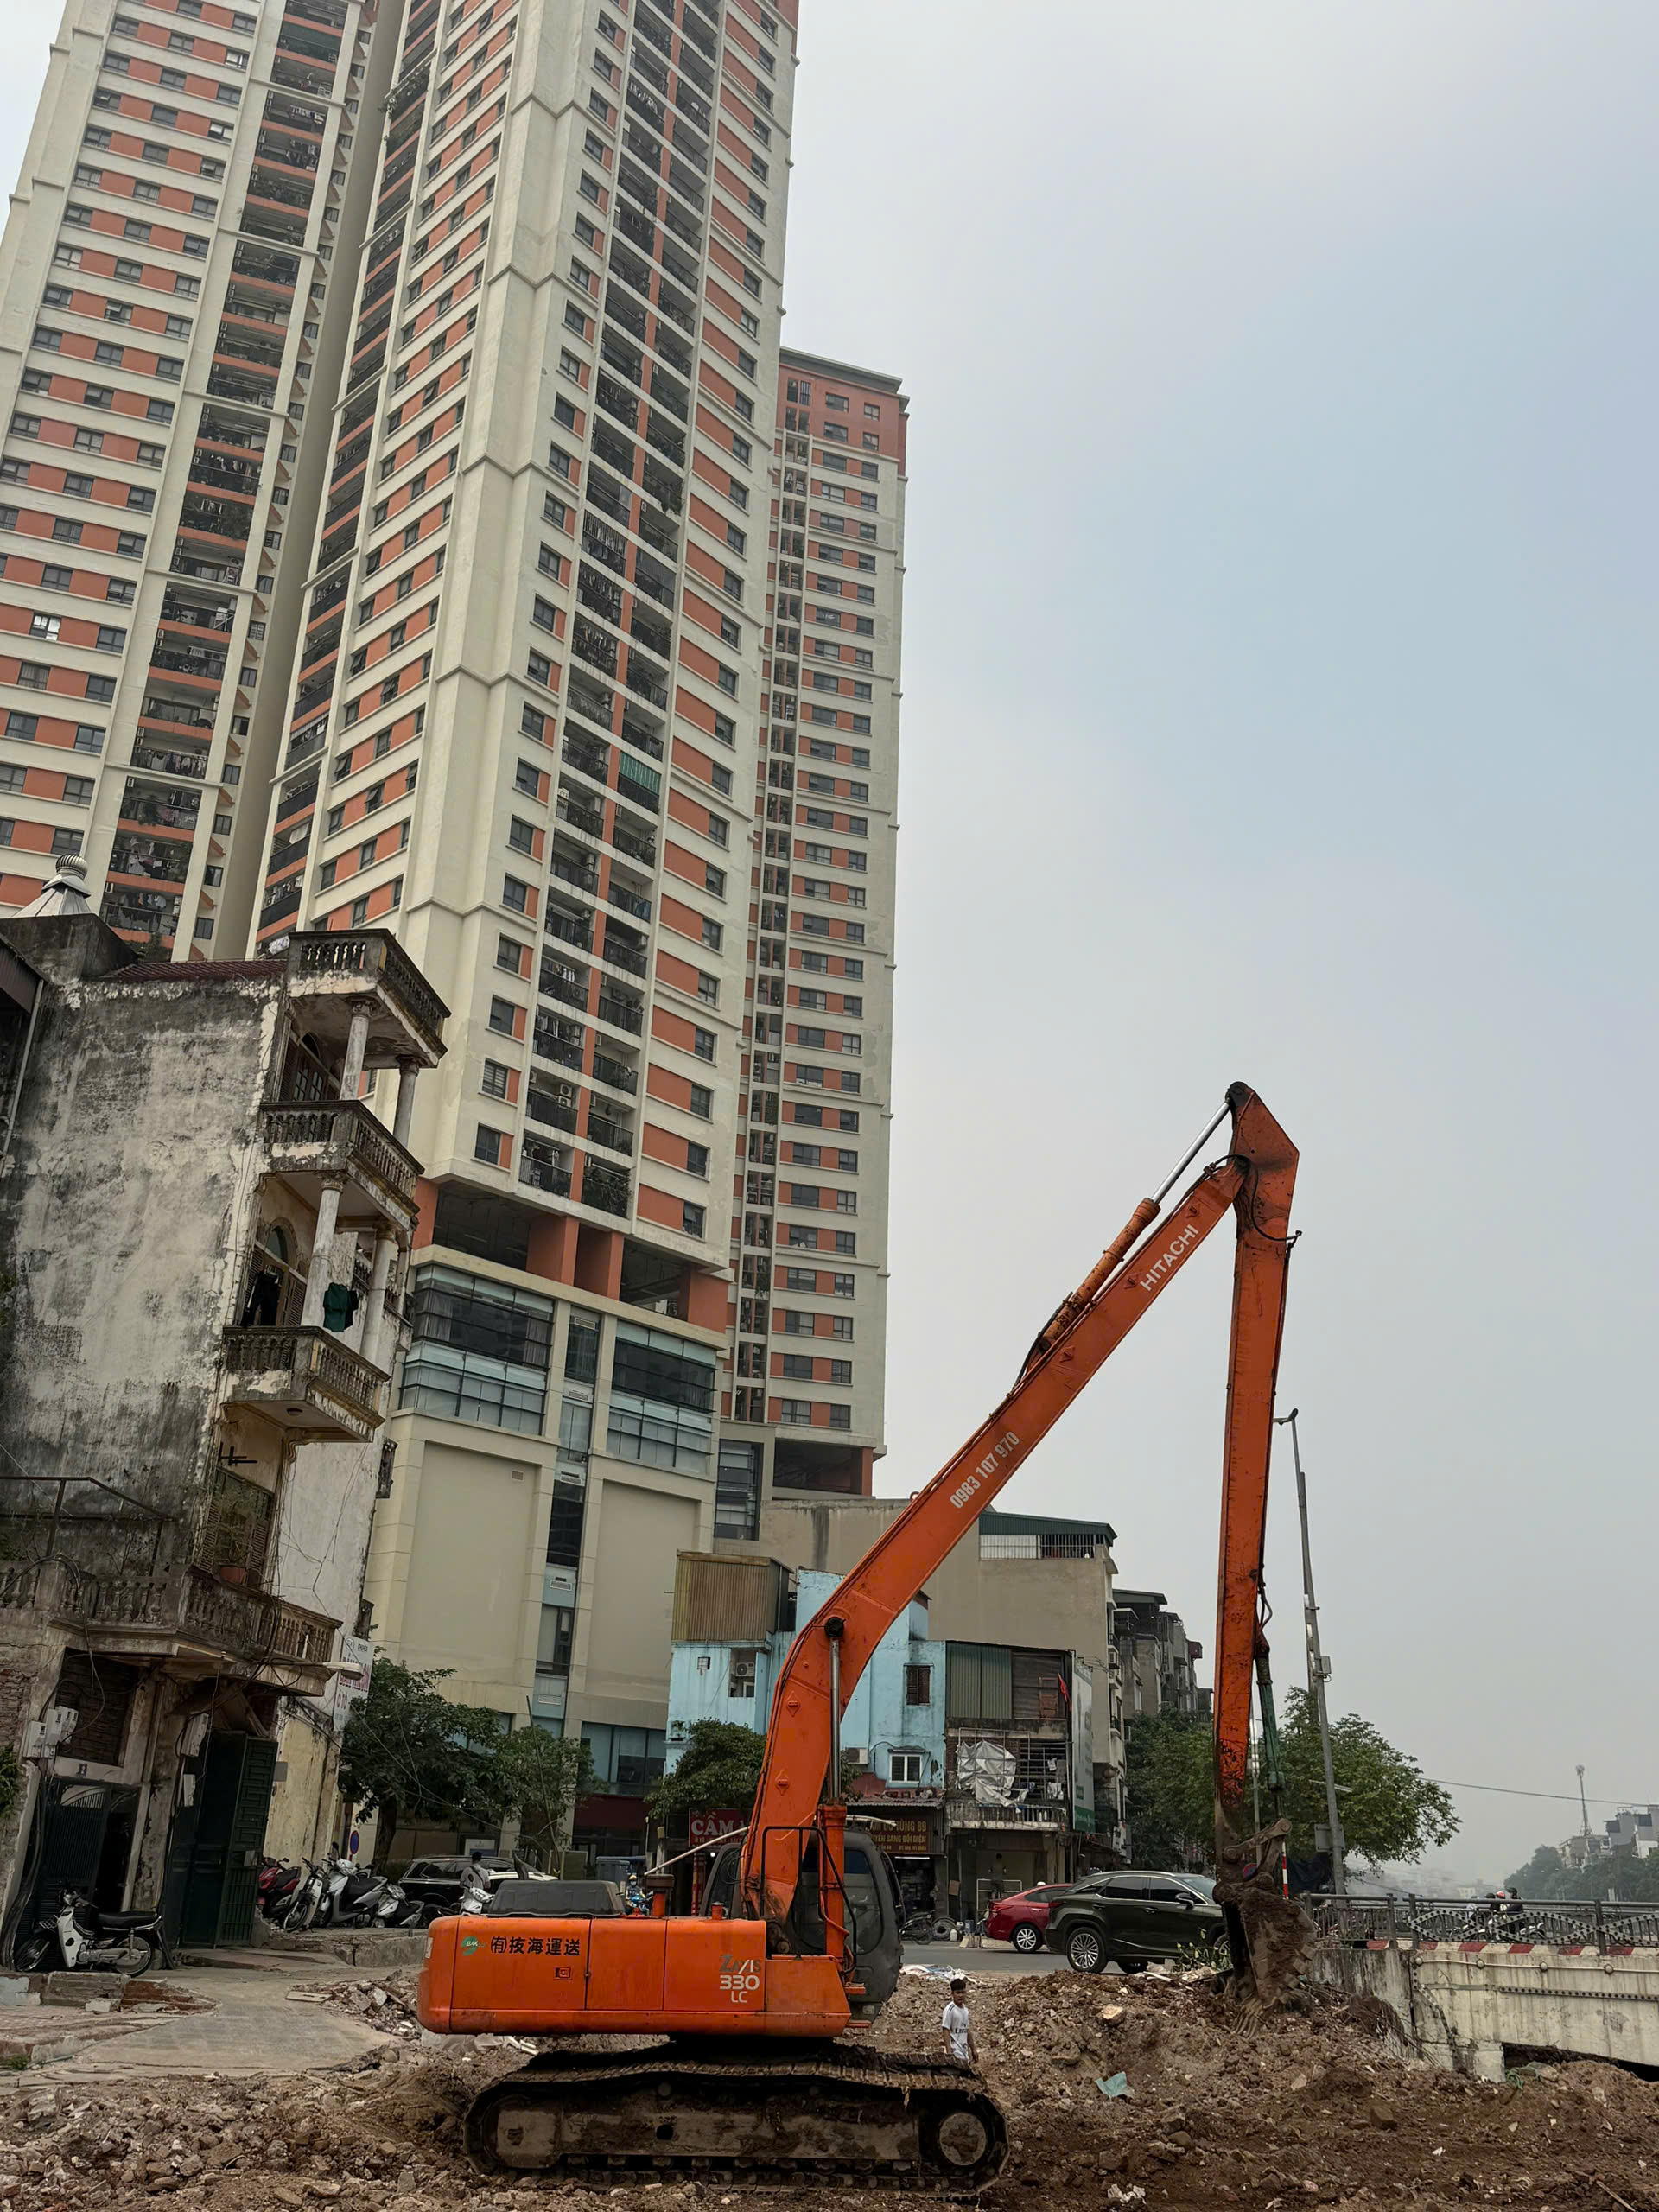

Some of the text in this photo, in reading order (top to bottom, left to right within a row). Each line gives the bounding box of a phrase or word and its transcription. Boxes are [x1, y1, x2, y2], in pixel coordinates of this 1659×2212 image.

[1140, 1224, 1199, 1291] HITACHI
[950, 1431, 1020, 1509] 0983 107 970
[691, 1811, 734, 1836] CẦM
[917, 1821, 927, 1832] 89
[719, 1974, 760, 1991] 330
[731, 1991, 747, 2003] LC
